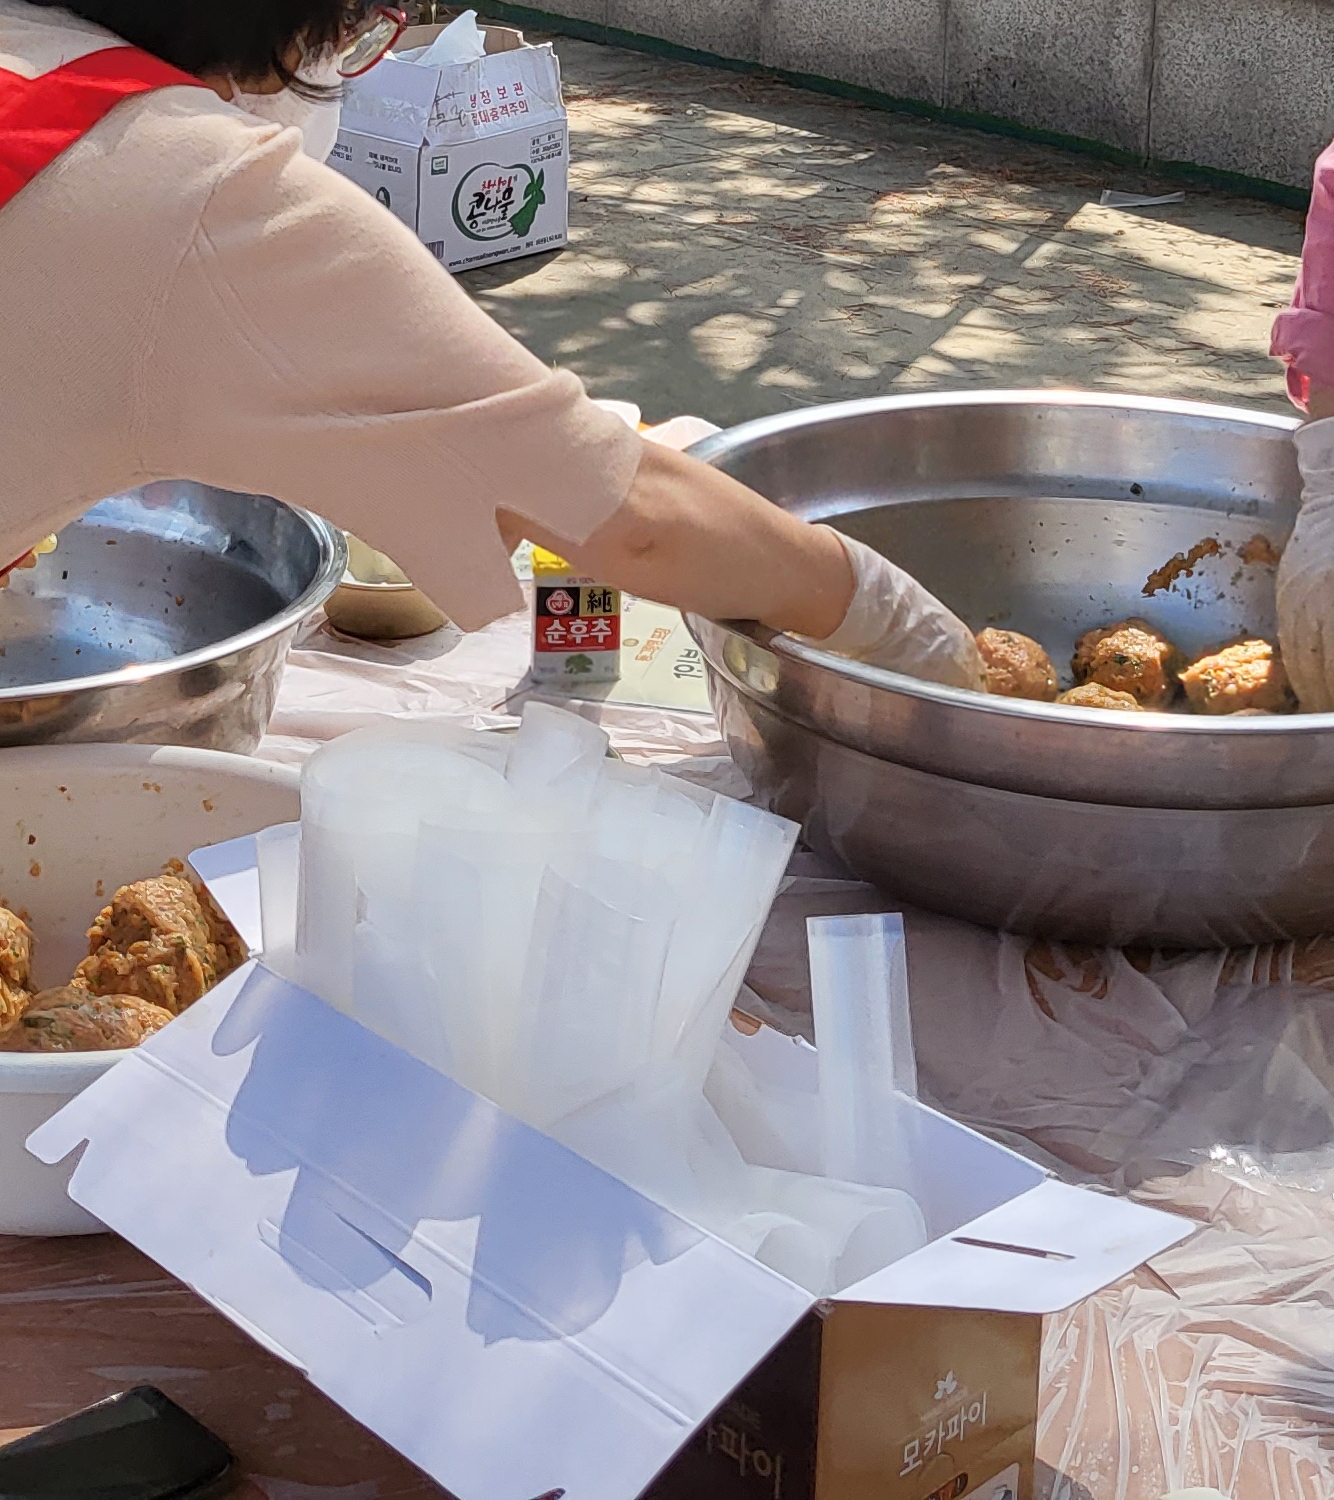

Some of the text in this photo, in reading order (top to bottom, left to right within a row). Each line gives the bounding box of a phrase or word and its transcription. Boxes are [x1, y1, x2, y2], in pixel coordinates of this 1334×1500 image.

[466, 186, 515, 230] 콩나물
[586, 588, 613, 614] 純
[545, 618, 612, 645] 순후추
[899, 1391, 988, 1477] 모카파이
